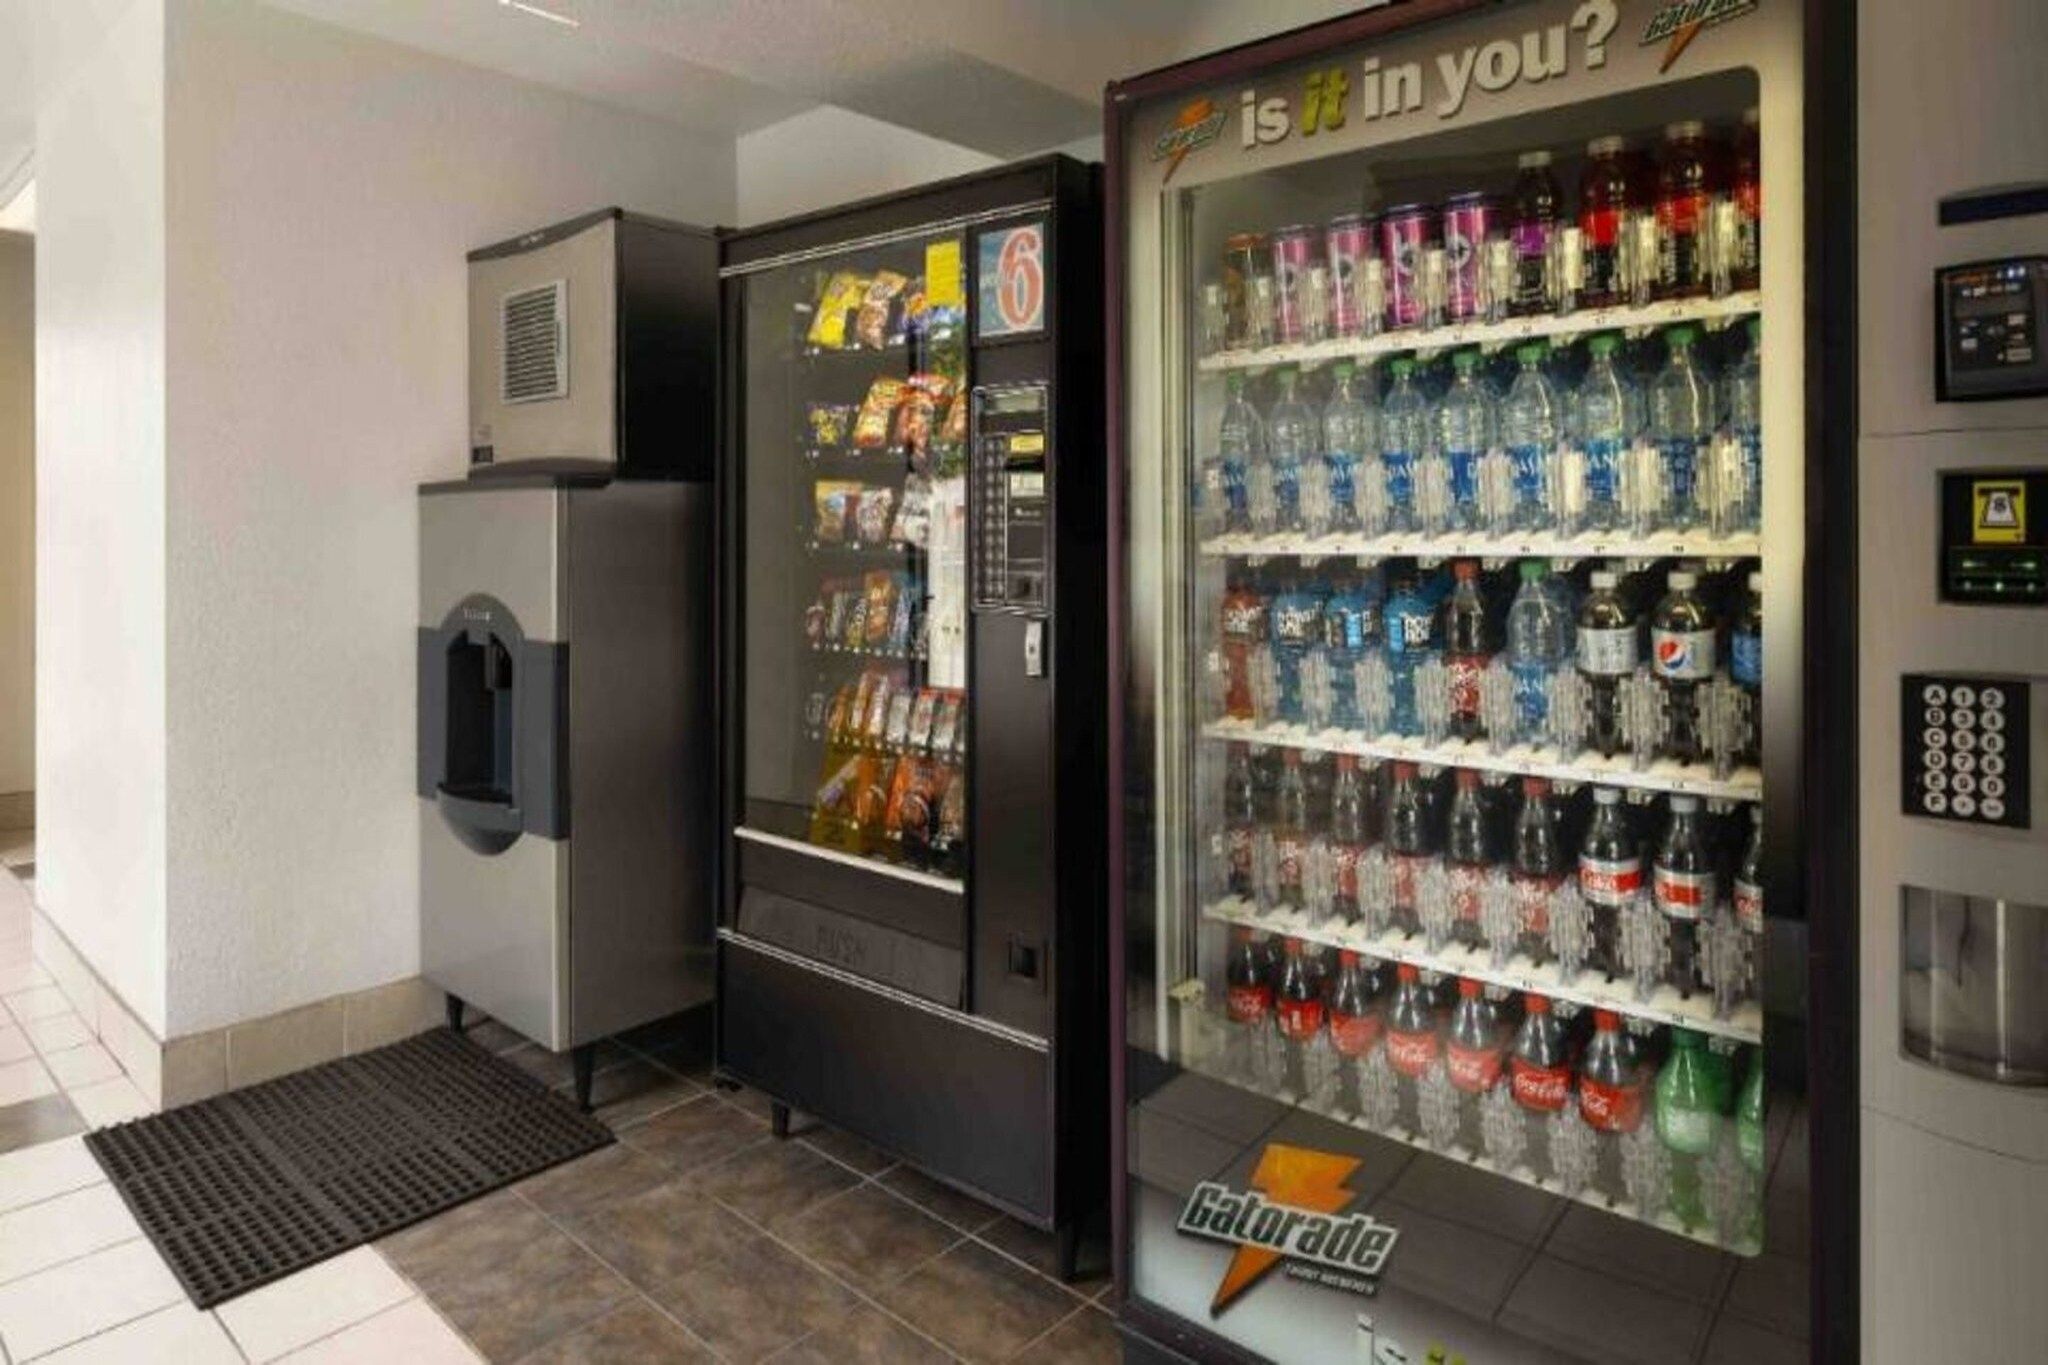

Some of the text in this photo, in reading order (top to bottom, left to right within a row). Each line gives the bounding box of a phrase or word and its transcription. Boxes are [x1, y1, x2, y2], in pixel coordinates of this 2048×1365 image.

[1240, 89, 1290, 149] is
[1302, 67, 1349, 136] it
[1364, 56, 1423, 122] in
[1436, 0, 1620, 118] you?
[998, 227, 1043, 332] 6
[1181, 1183, 1395, 1271] Gatorade
